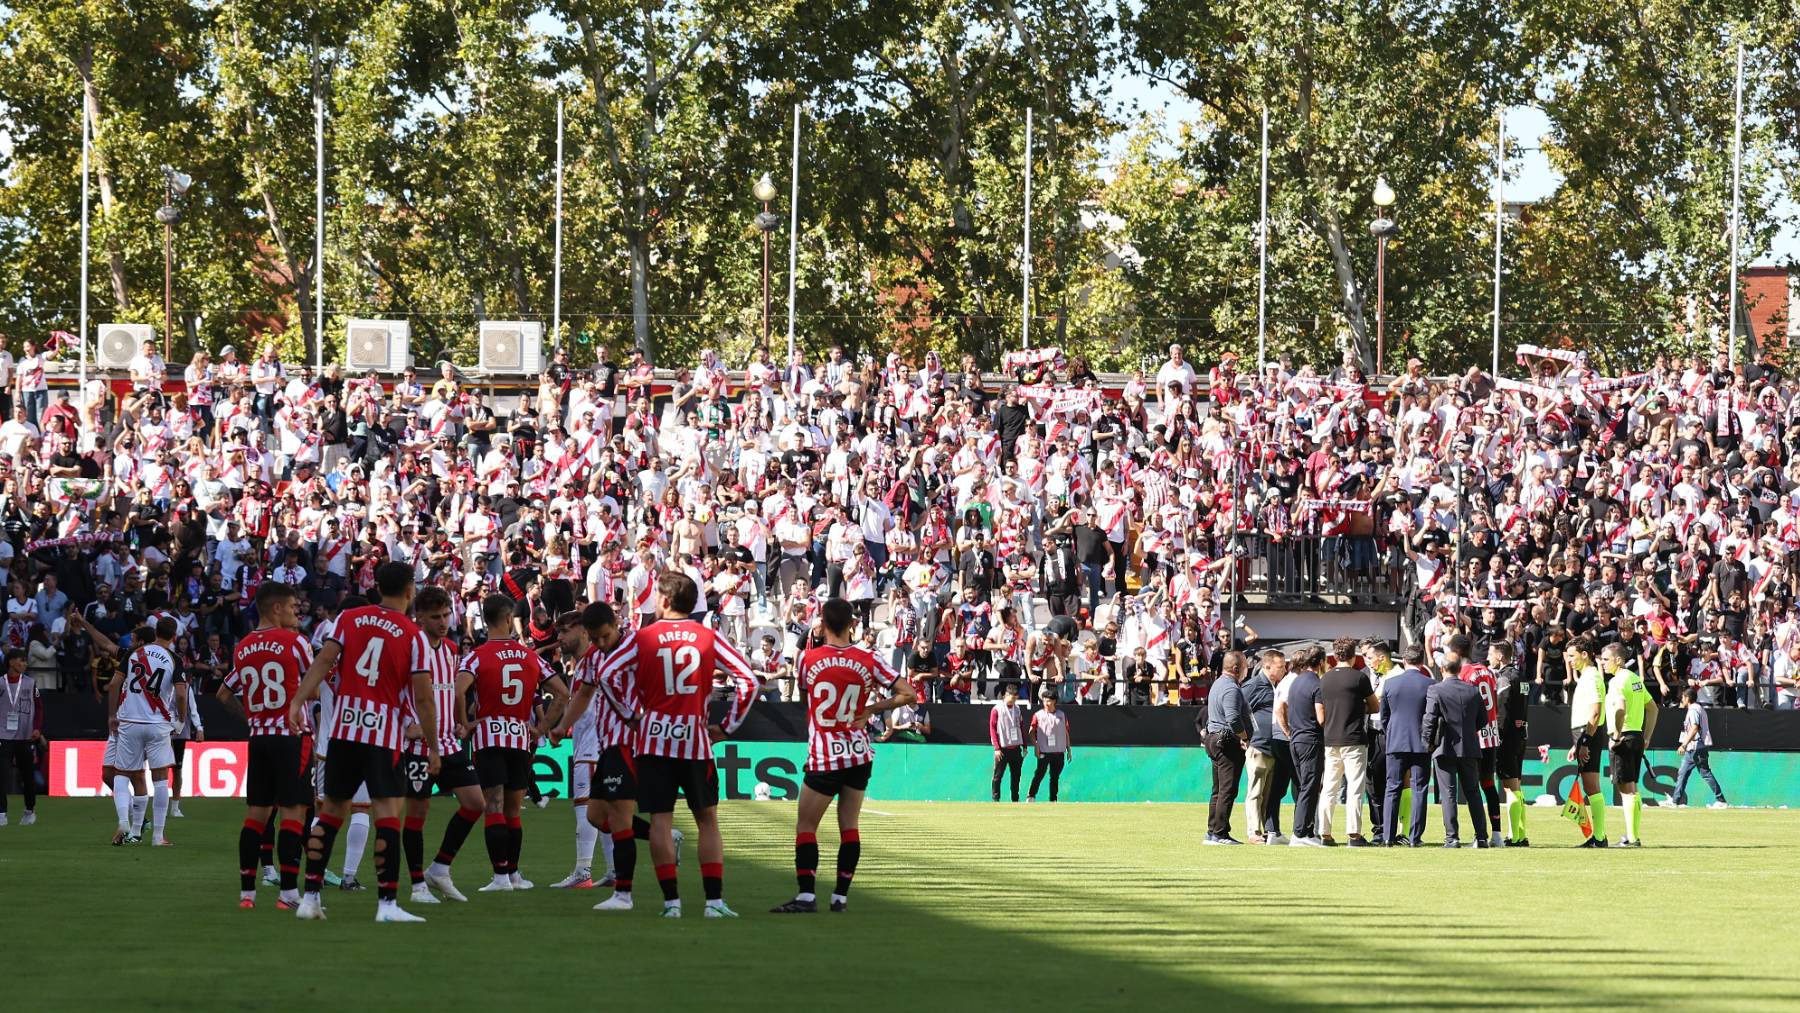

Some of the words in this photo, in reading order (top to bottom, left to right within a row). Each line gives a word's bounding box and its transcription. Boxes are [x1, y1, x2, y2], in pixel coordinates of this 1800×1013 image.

[354, 614, 404, 639] PAREDES
[658, 630, 697, 644] ARESO
[237, 640, 285, 661] CANALES
[355, 636, 385, 687] 4
[496, 649, 527, 661] YERAY
[129, 662, 166, 698] 24
[656, 645, 701, 696] 12
[240, 661, 287, 713] 28
[501, 663, 524, 706] 5
[1479, 681, 1494, 711] 9
[813, 681, 862, 728] 24
[342, 708, 384, 730] DIGI
[490, 721, 526, 737] DIGI
[649, 721, 692, 740] DIGI
[831, 739, 868, 756] DIG
[65, 747, 247, 797] LIG
[408, 761, 429, 780] 23
